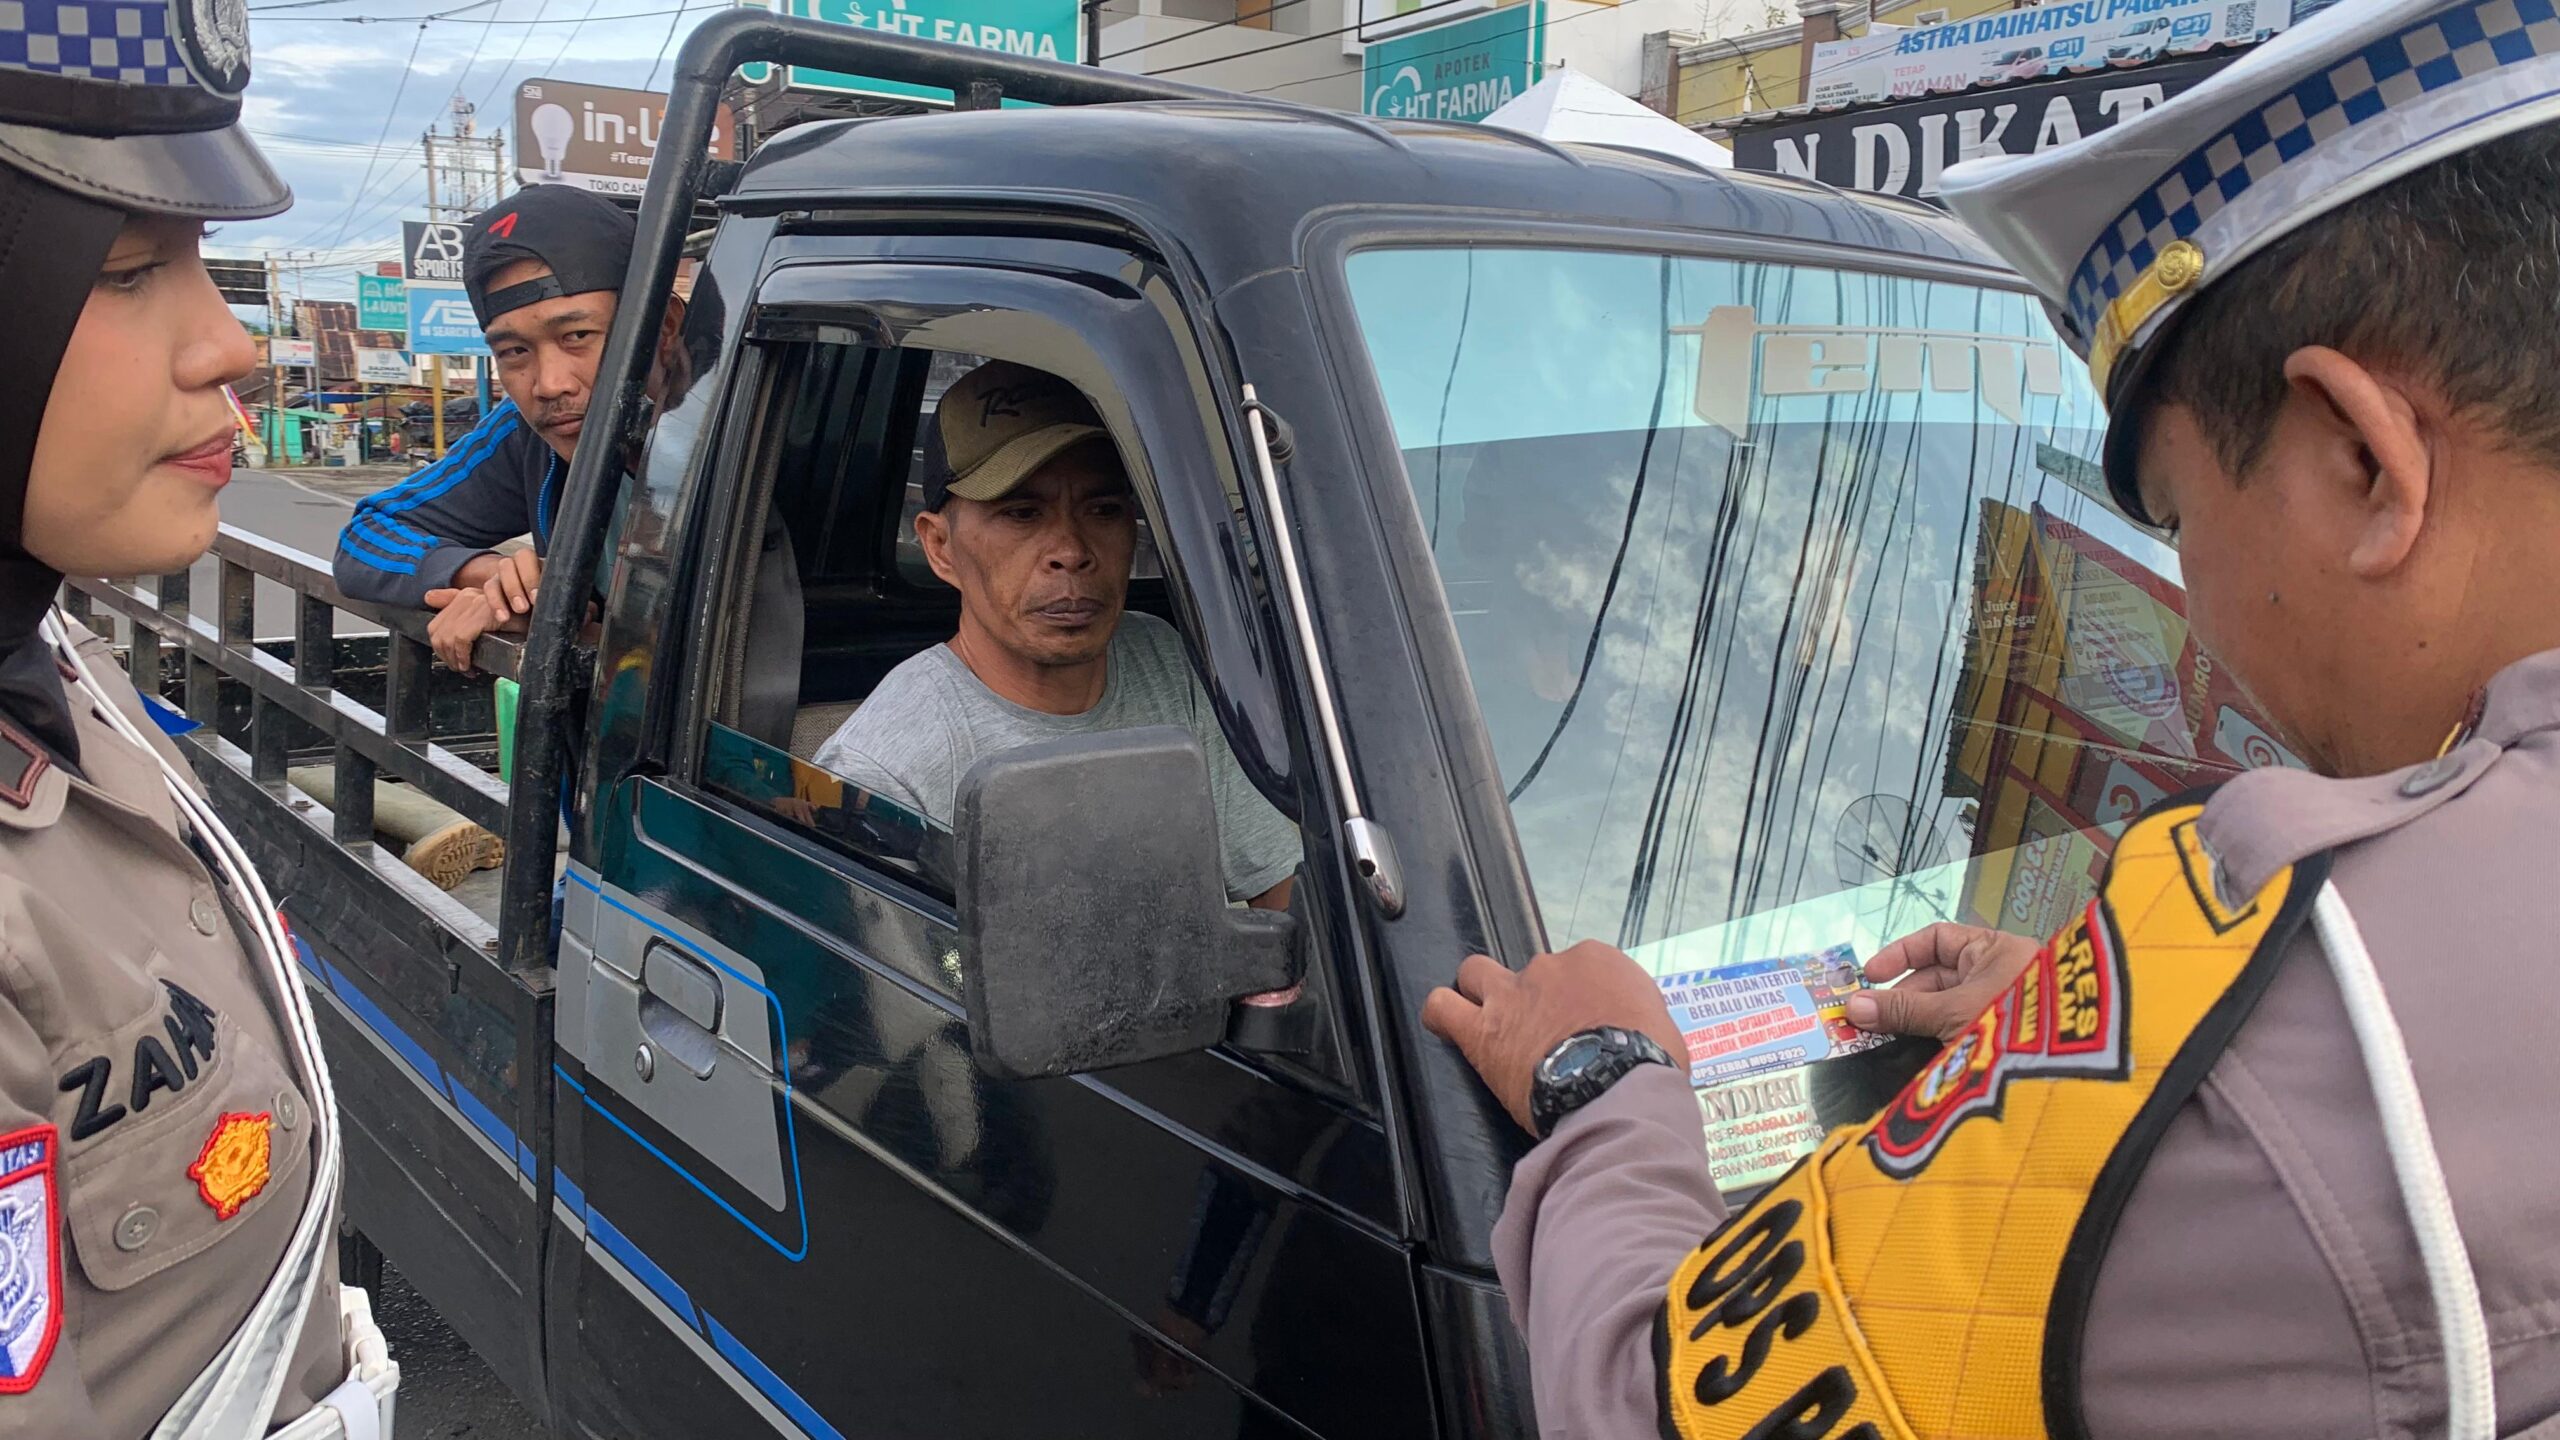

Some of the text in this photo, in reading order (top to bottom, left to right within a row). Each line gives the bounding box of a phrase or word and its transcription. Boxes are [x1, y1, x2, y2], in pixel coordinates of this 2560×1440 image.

[934, 22, 1058, 61] FARMA
[1895, 22, 1970, 56] ASTRA
[1974, 0, 2101, 43] DAIHATSU
[1434, 51, 1491, 81] APOTEK
[1894, 64, 1926, 77] TETAP
[1405, 75, 1513, 120] HT FARMA
[1893, 72, 1968, 99] NYAMAN
[588, 179, 645, 195] TOKO CAH
[414, 224, 465, 261] AB
[414, 259, 464, 278] SPORTS
[365, 301, 406, 314] LAUND
[1983, 600, 2017, 614] Juice
[2004, 614, 2037, 629] Segar
[1664, 970, 1802, 1007] AMI PATUH DAN TERTIB
[1688, 990, 1786, 1020] BERLALU LINTAS
[1692, 1066, 1716, 1080] OPS
[1716, 1059, 1750, 1074] ZEBRA
[1749, 1052, 1779, 1068] MUSI
[1778, 1046, 1807, 1062] 2025
[1686, 1198, 1821, 1407] OPS
